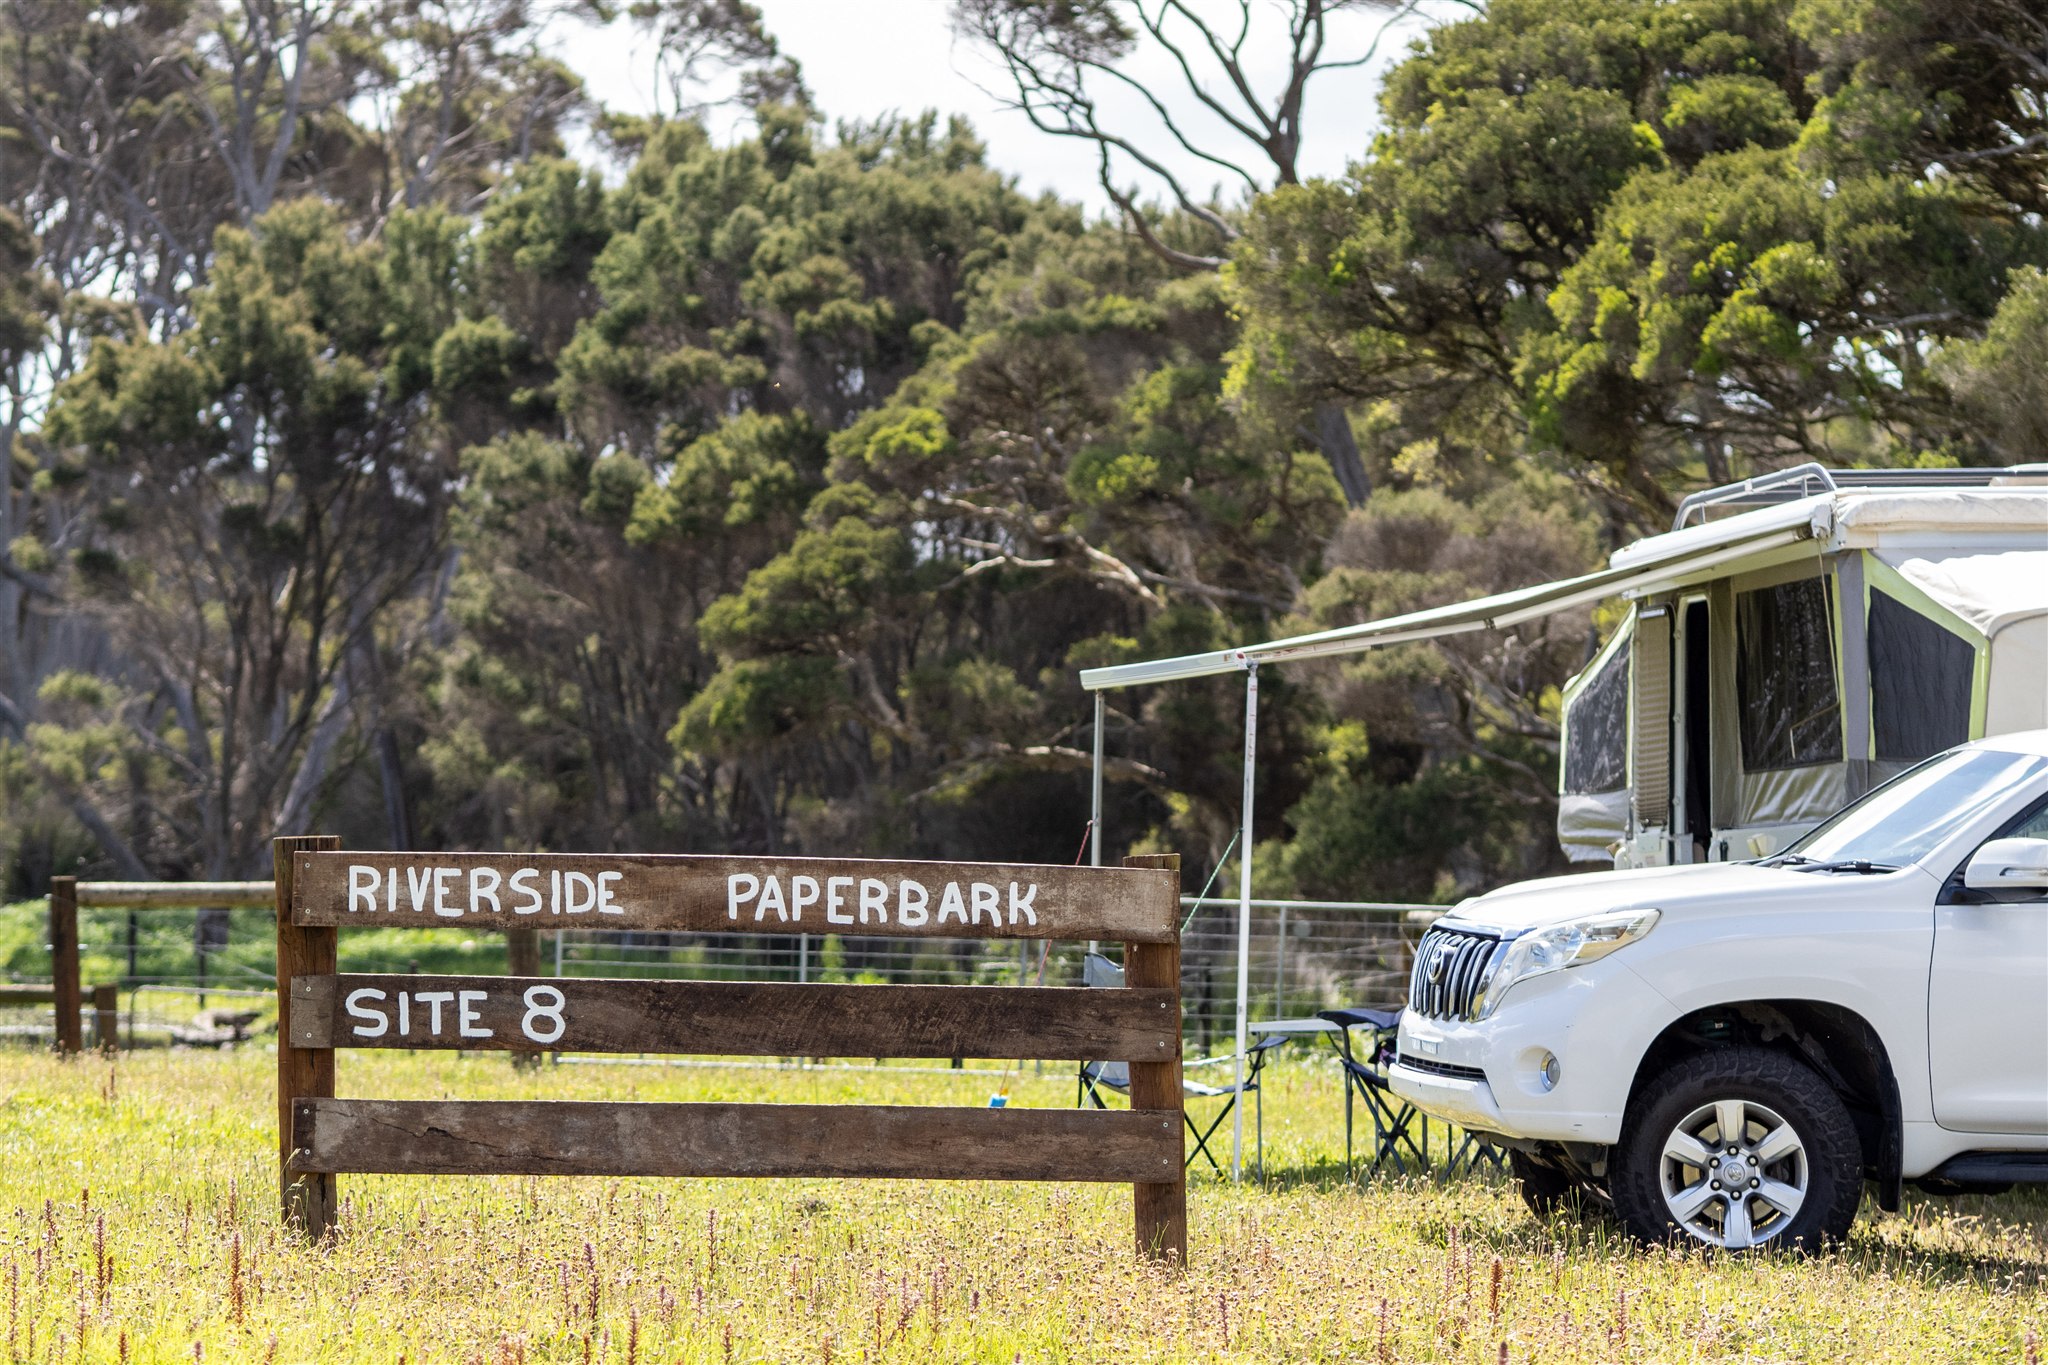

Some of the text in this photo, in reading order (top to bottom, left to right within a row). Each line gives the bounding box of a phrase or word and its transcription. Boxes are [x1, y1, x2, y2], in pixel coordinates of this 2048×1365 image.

[348, 864, 1038, 927] RIVERSIDE PAPERBARK
[345, 984, 566, 1044] SITE 8
